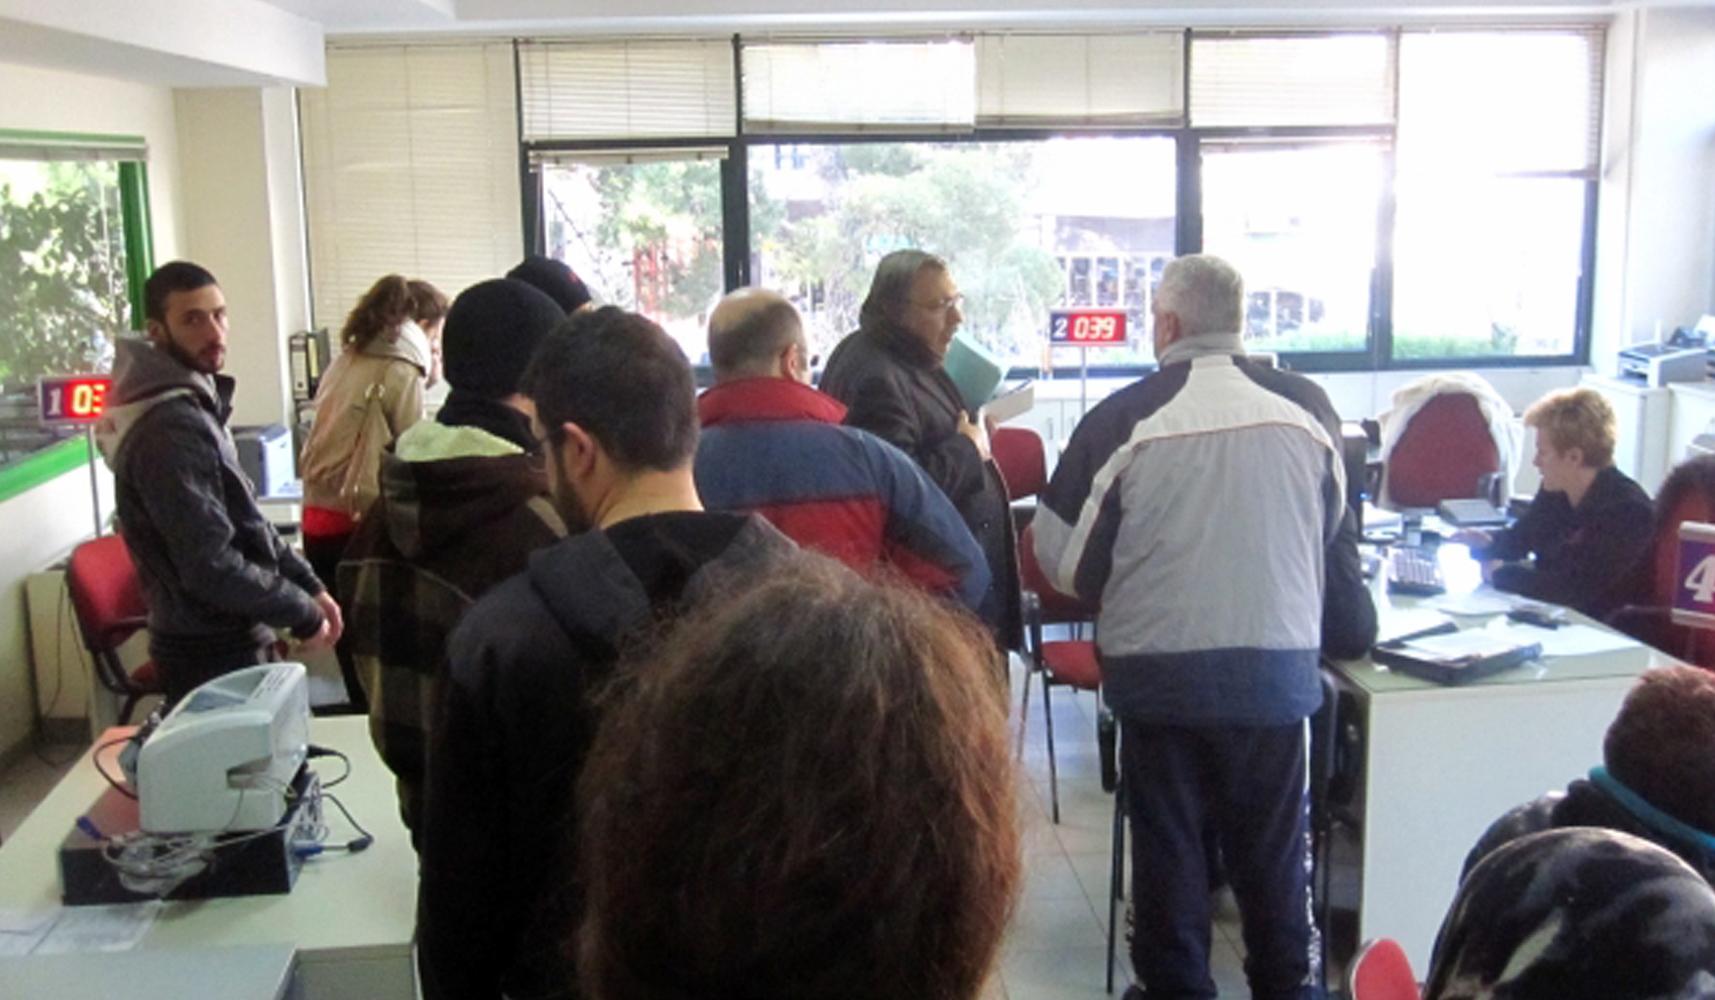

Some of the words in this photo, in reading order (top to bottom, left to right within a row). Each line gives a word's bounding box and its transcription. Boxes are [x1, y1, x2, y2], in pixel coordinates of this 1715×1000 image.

[1053, 318, 1067, 338] 2
[1074, 317, 1116, 339] 039
[47, 388, 61, 415] 1
[1684, 554, 1715, 603] 4
